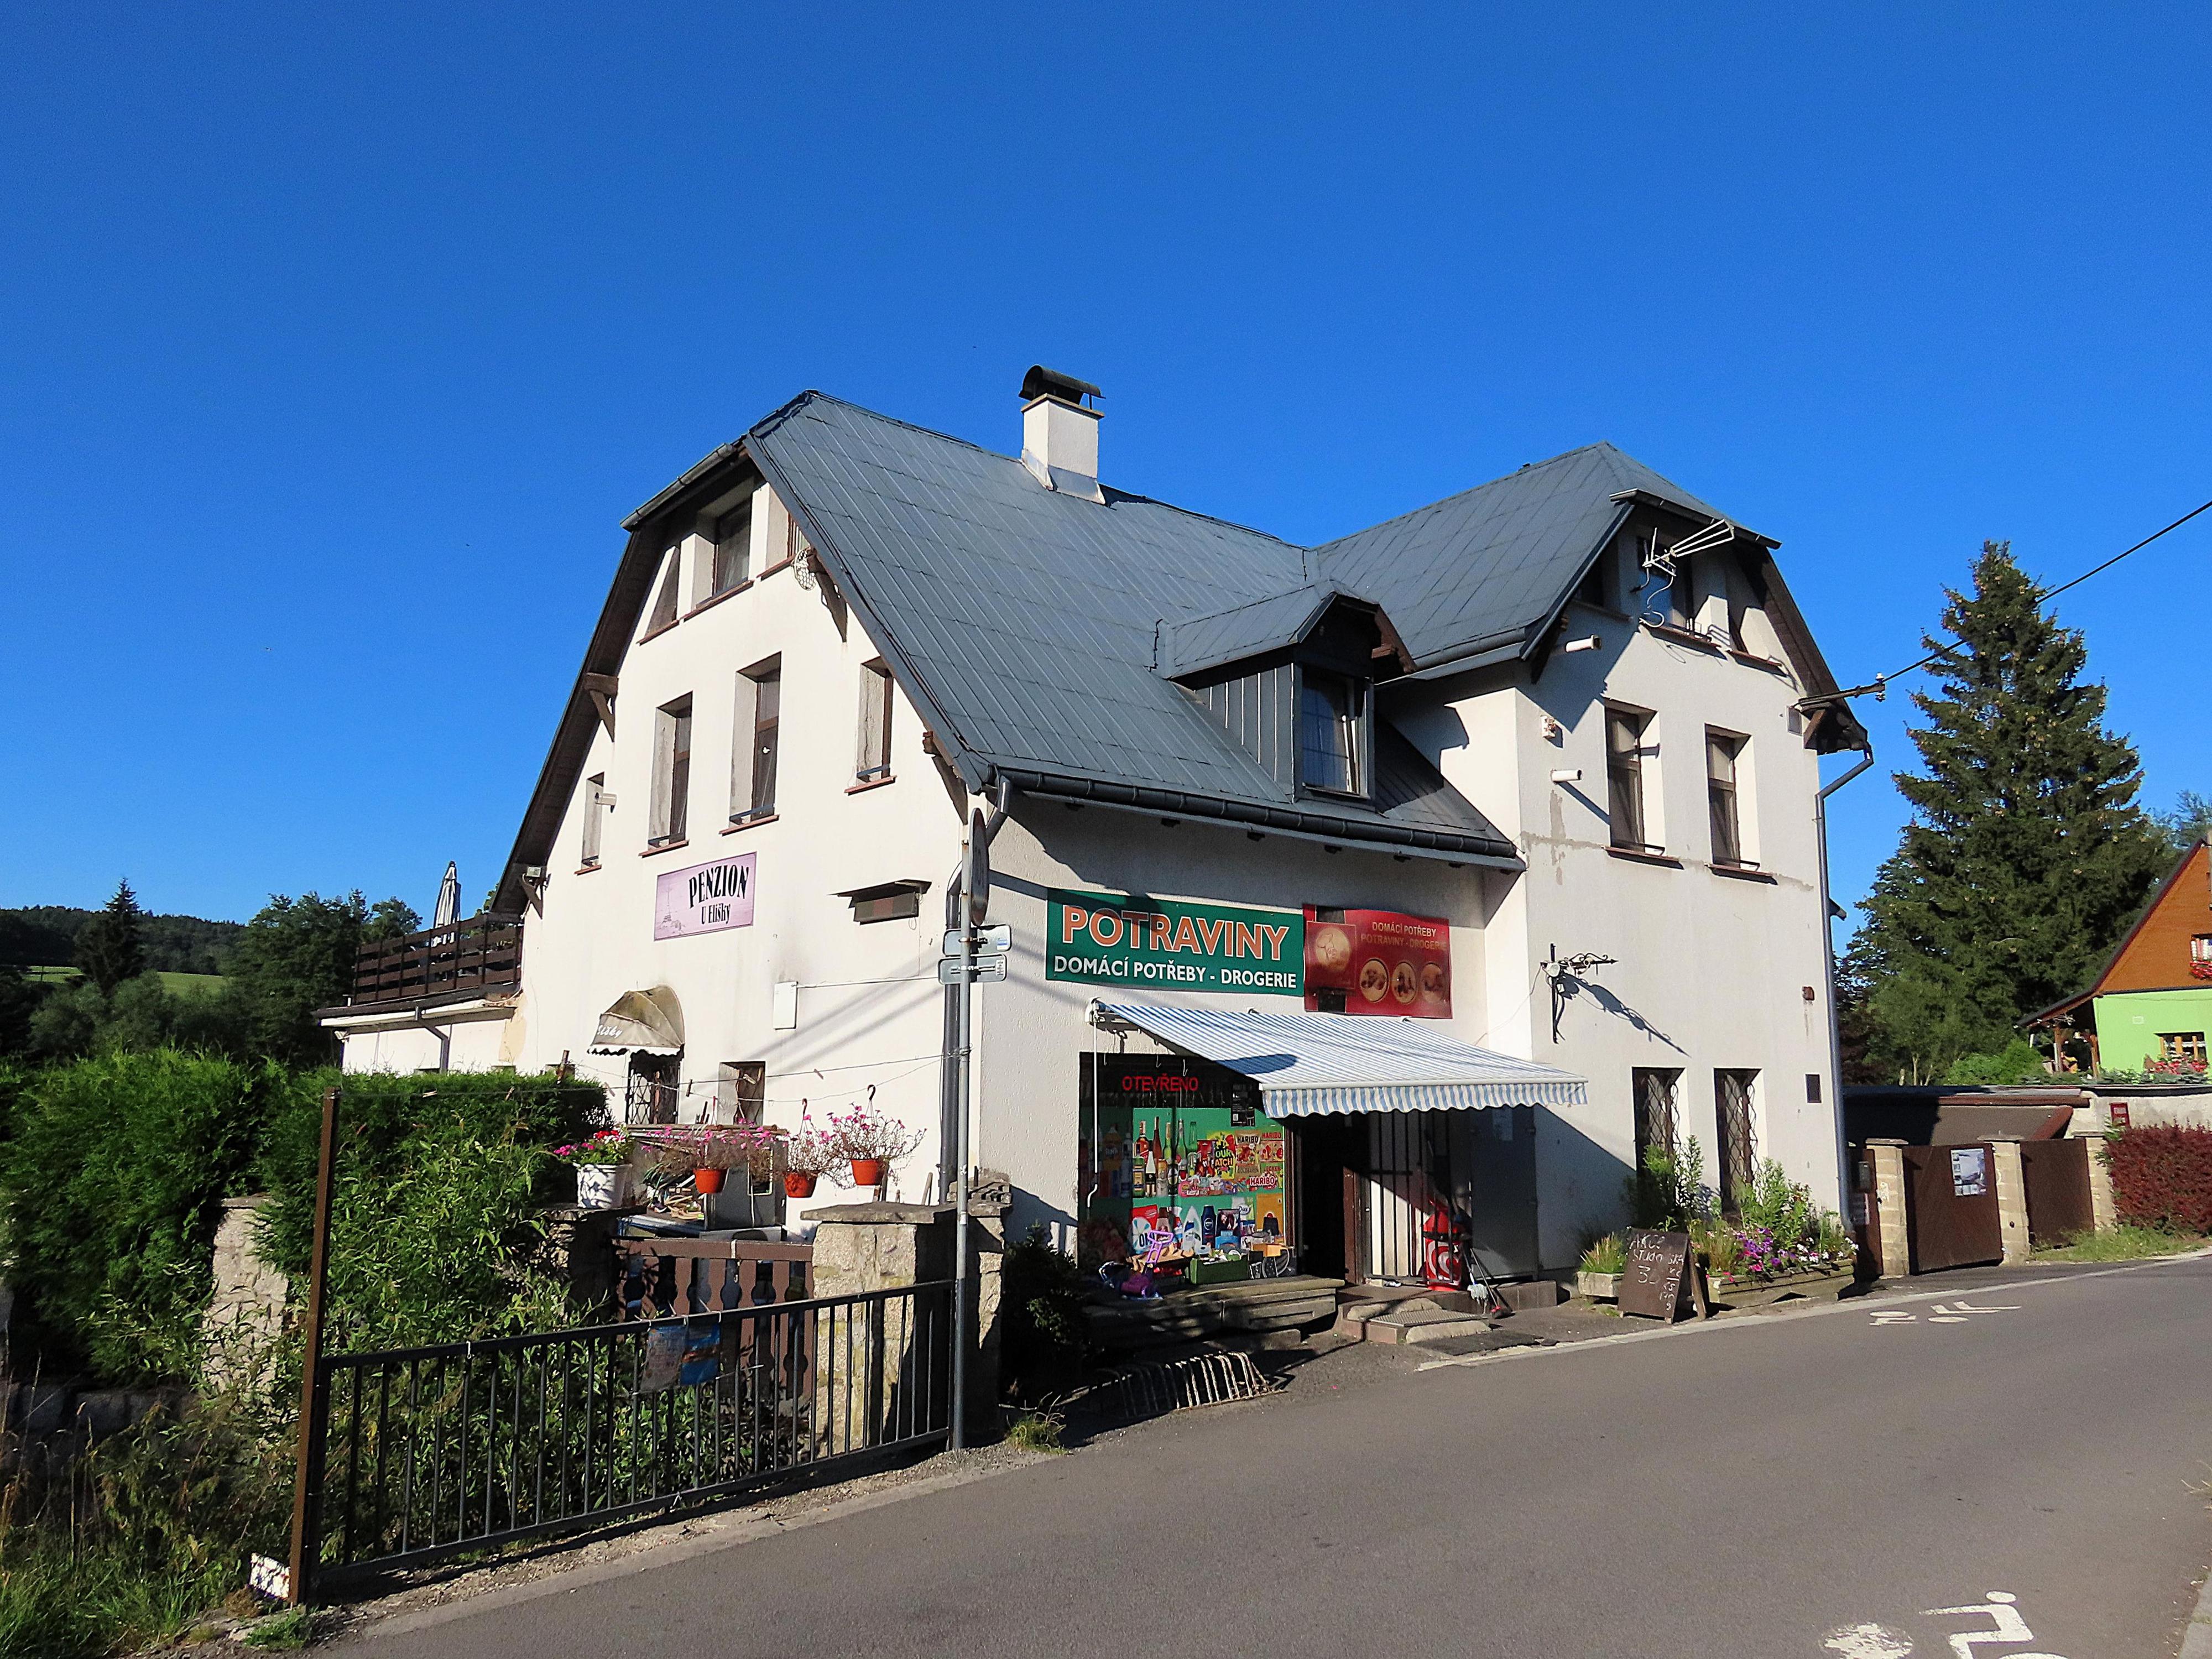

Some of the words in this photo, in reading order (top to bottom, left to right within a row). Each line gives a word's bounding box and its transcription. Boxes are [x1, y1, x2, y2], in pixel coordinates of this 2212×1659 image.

[688, 864, 749, 909] PENZION
[701, 906, 706, 925] U
[708, 902, 731, 924] Elišky
[1062, 904, 1290, 961] POTRAVINY
[1372, 922, 1402, 933] DOMÁCÍ
[1404, 925, 1436, 937] POTŘEBY
[1361, 933, 1404, 946] POTRAVINY
[1410, 938, 1448, 951] DROGERIE
[1054, 955, 1129, 977] DOMÁCÍ
[1134, 959, 1206, 982] POTŘEBY
[1221, 968, 1297, 988] DROGERIE
[1122, 1073, 1198, 1092] OTEVŘENO
[1215, 1149, 1231, 1157] OUR
[1215, 1157, 1233, 1166] ATCH
[1250, 1176, 1275, 1186] HARIBO
[1139, 1233, 1155, 1248] OM
